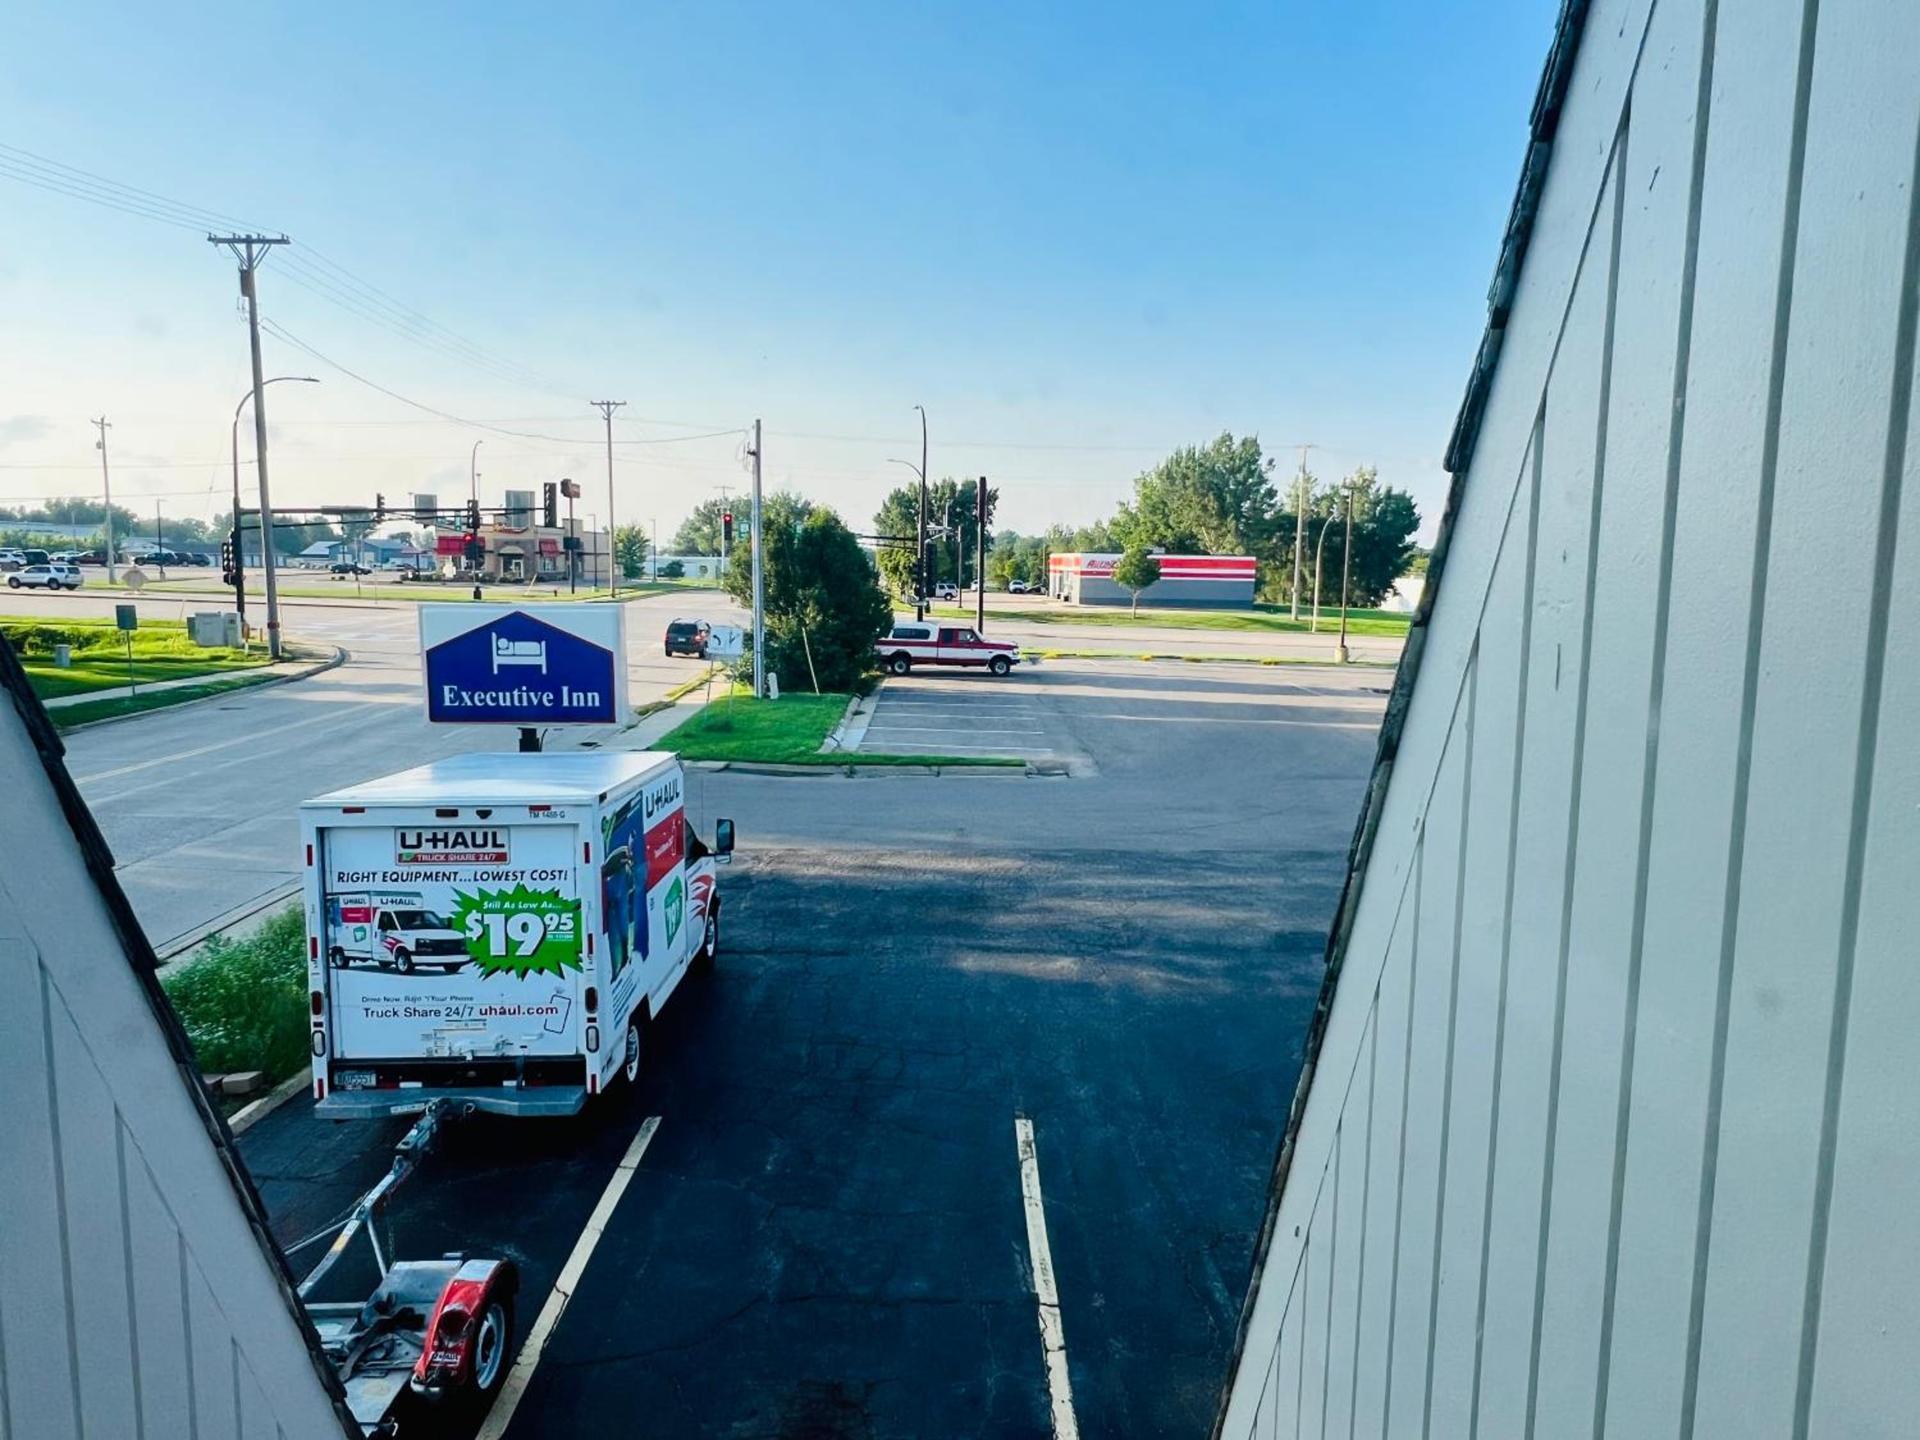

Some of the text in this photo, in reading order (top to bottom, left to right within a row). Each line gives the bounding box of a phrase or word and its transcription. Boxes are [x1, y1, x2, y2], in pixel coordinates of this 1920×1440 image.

[443, 685, 600, 707] Executive Inn
[400, 831, 506, 850] U-HAUL
[417, 853, 497, 862] TRUCK SHARE 24/7
[337, 872, 377, 883] RIGHT
[530, 869, 568, 881] COST!
[483, 901, 501, 910] Still
[503, 901, 515, 909] As
[518, 901, 538, 909] Low
[364, 1004, 559, 1018] Truck Share 24/7 uhaul.com
